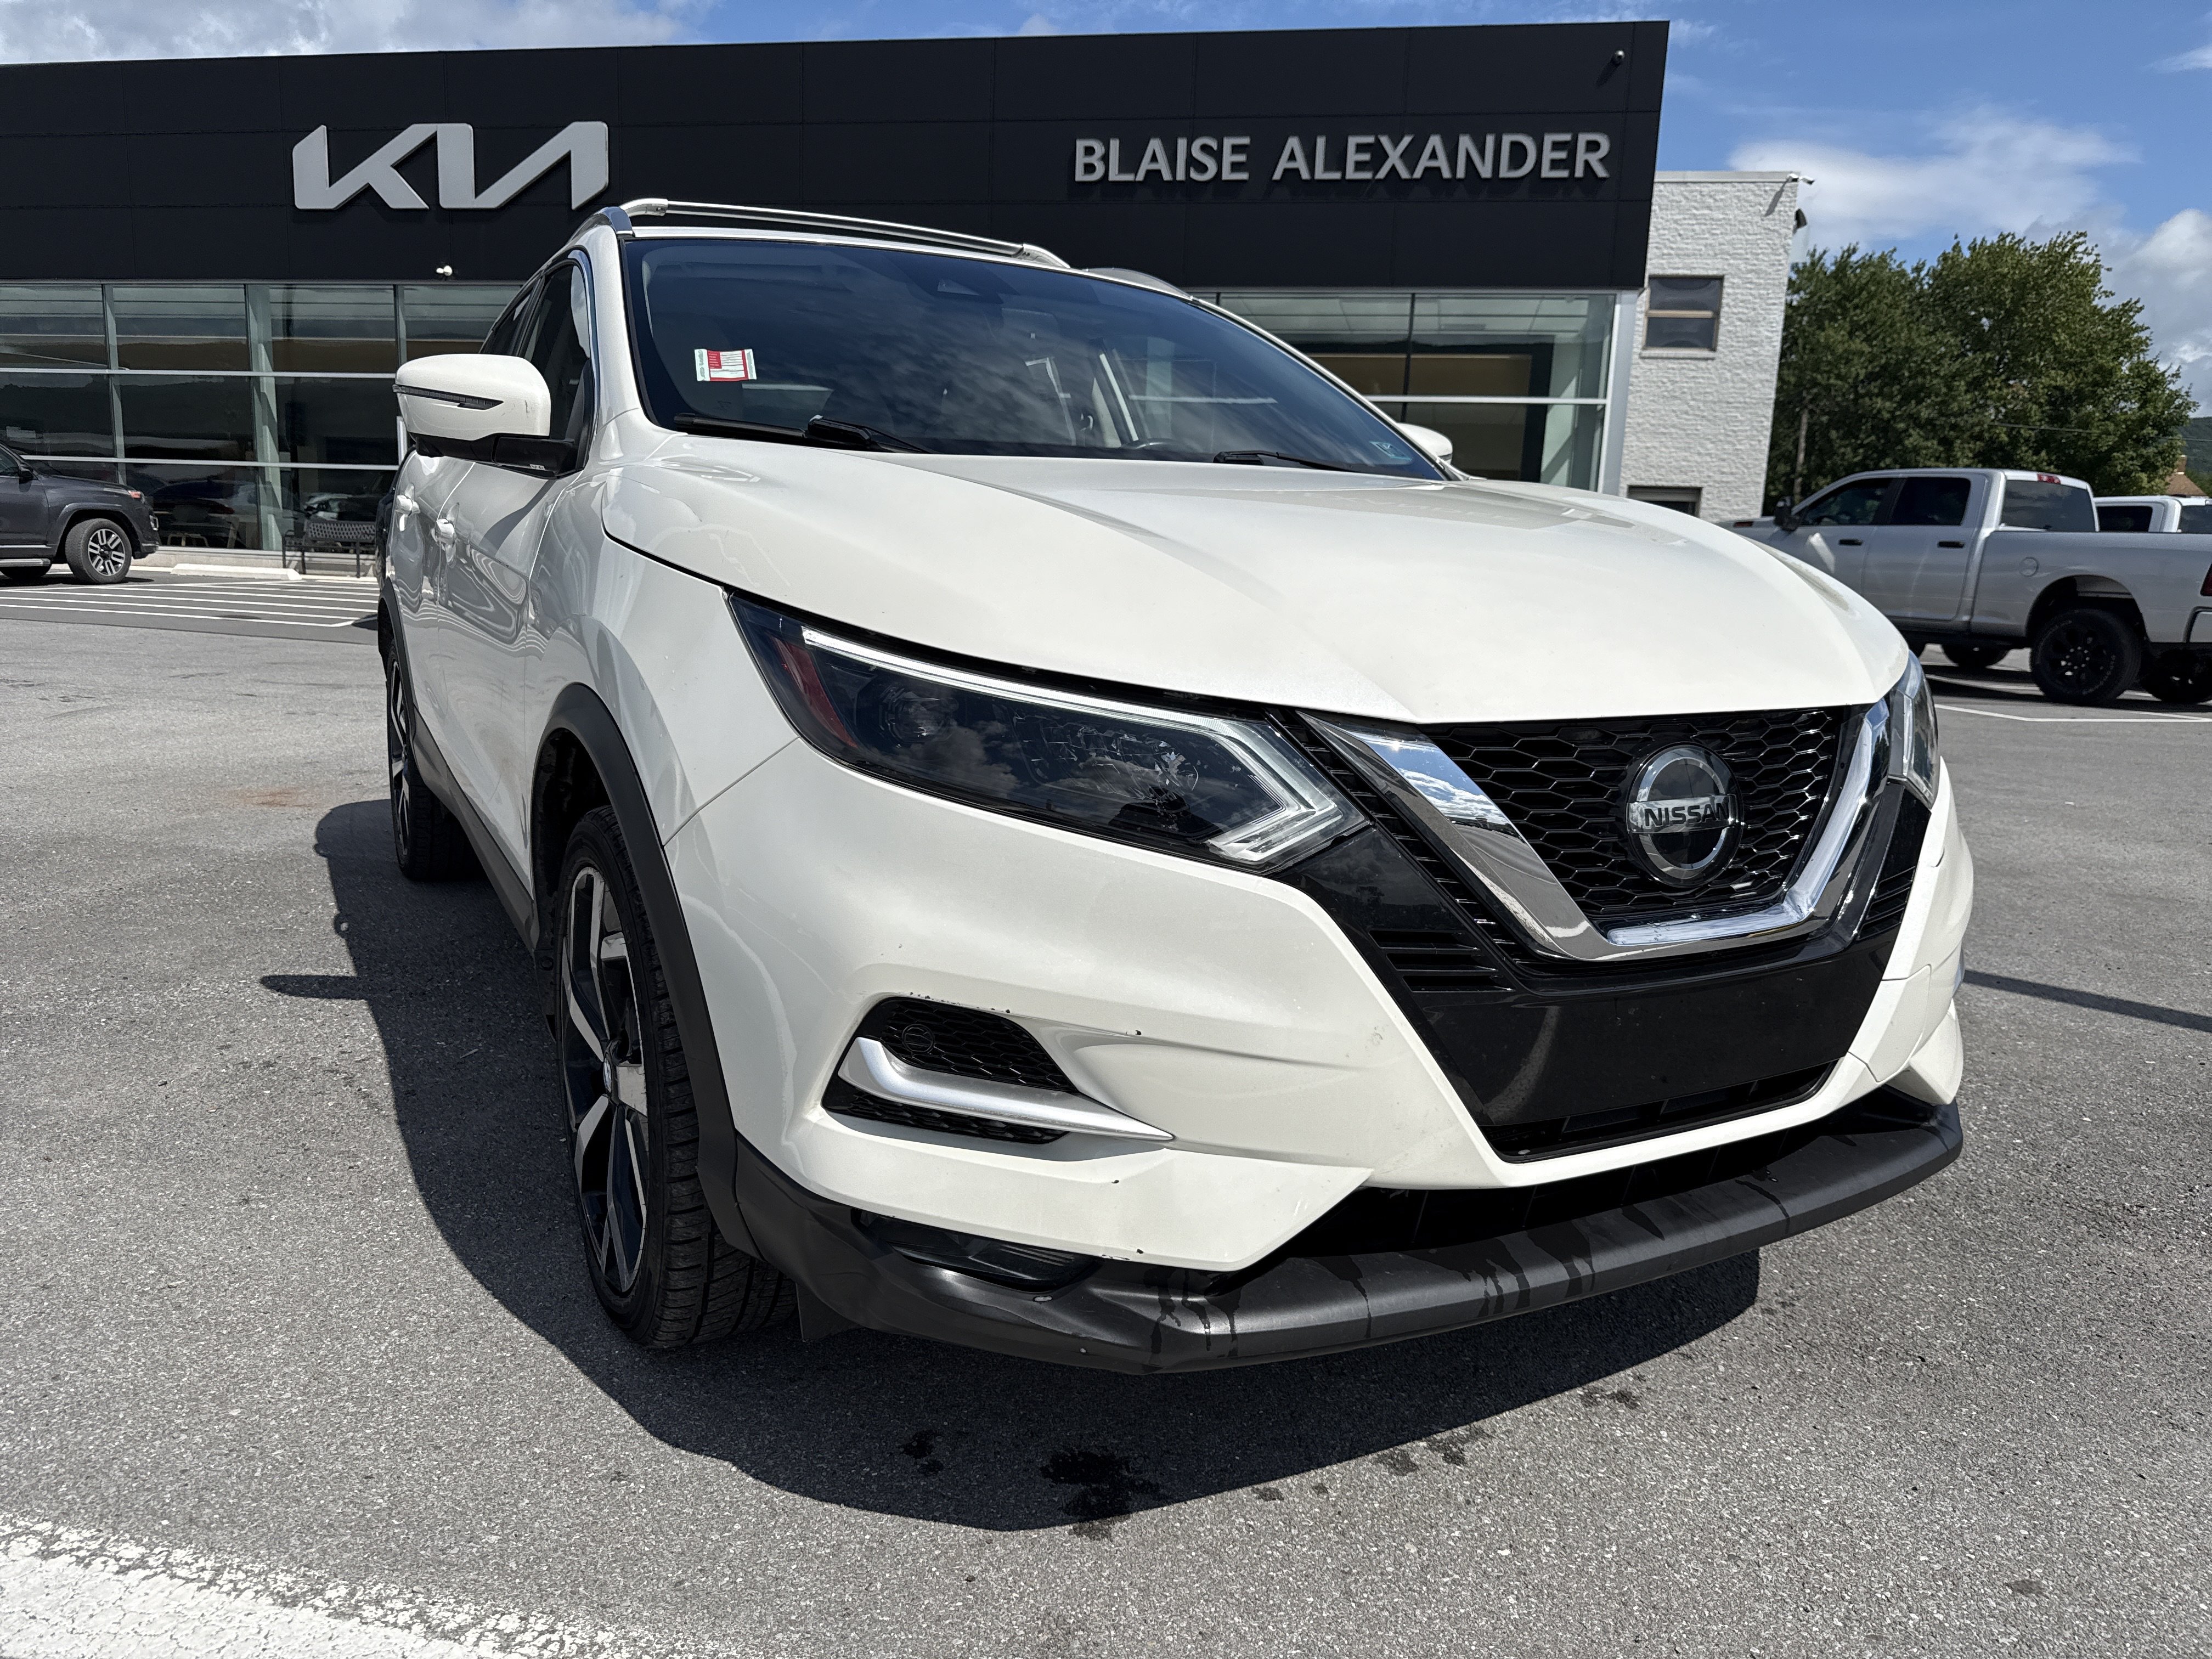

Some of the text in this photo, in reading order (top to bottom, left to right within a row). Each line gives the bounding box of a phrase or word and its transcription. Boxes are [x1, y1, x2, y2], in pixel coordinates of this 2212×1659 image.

[292, 121, 609, 211] KIA
[1075, 133, 1611, 183] BLAISE ALEXANDER
[1644, 802, 1729, 827] NISSAN
